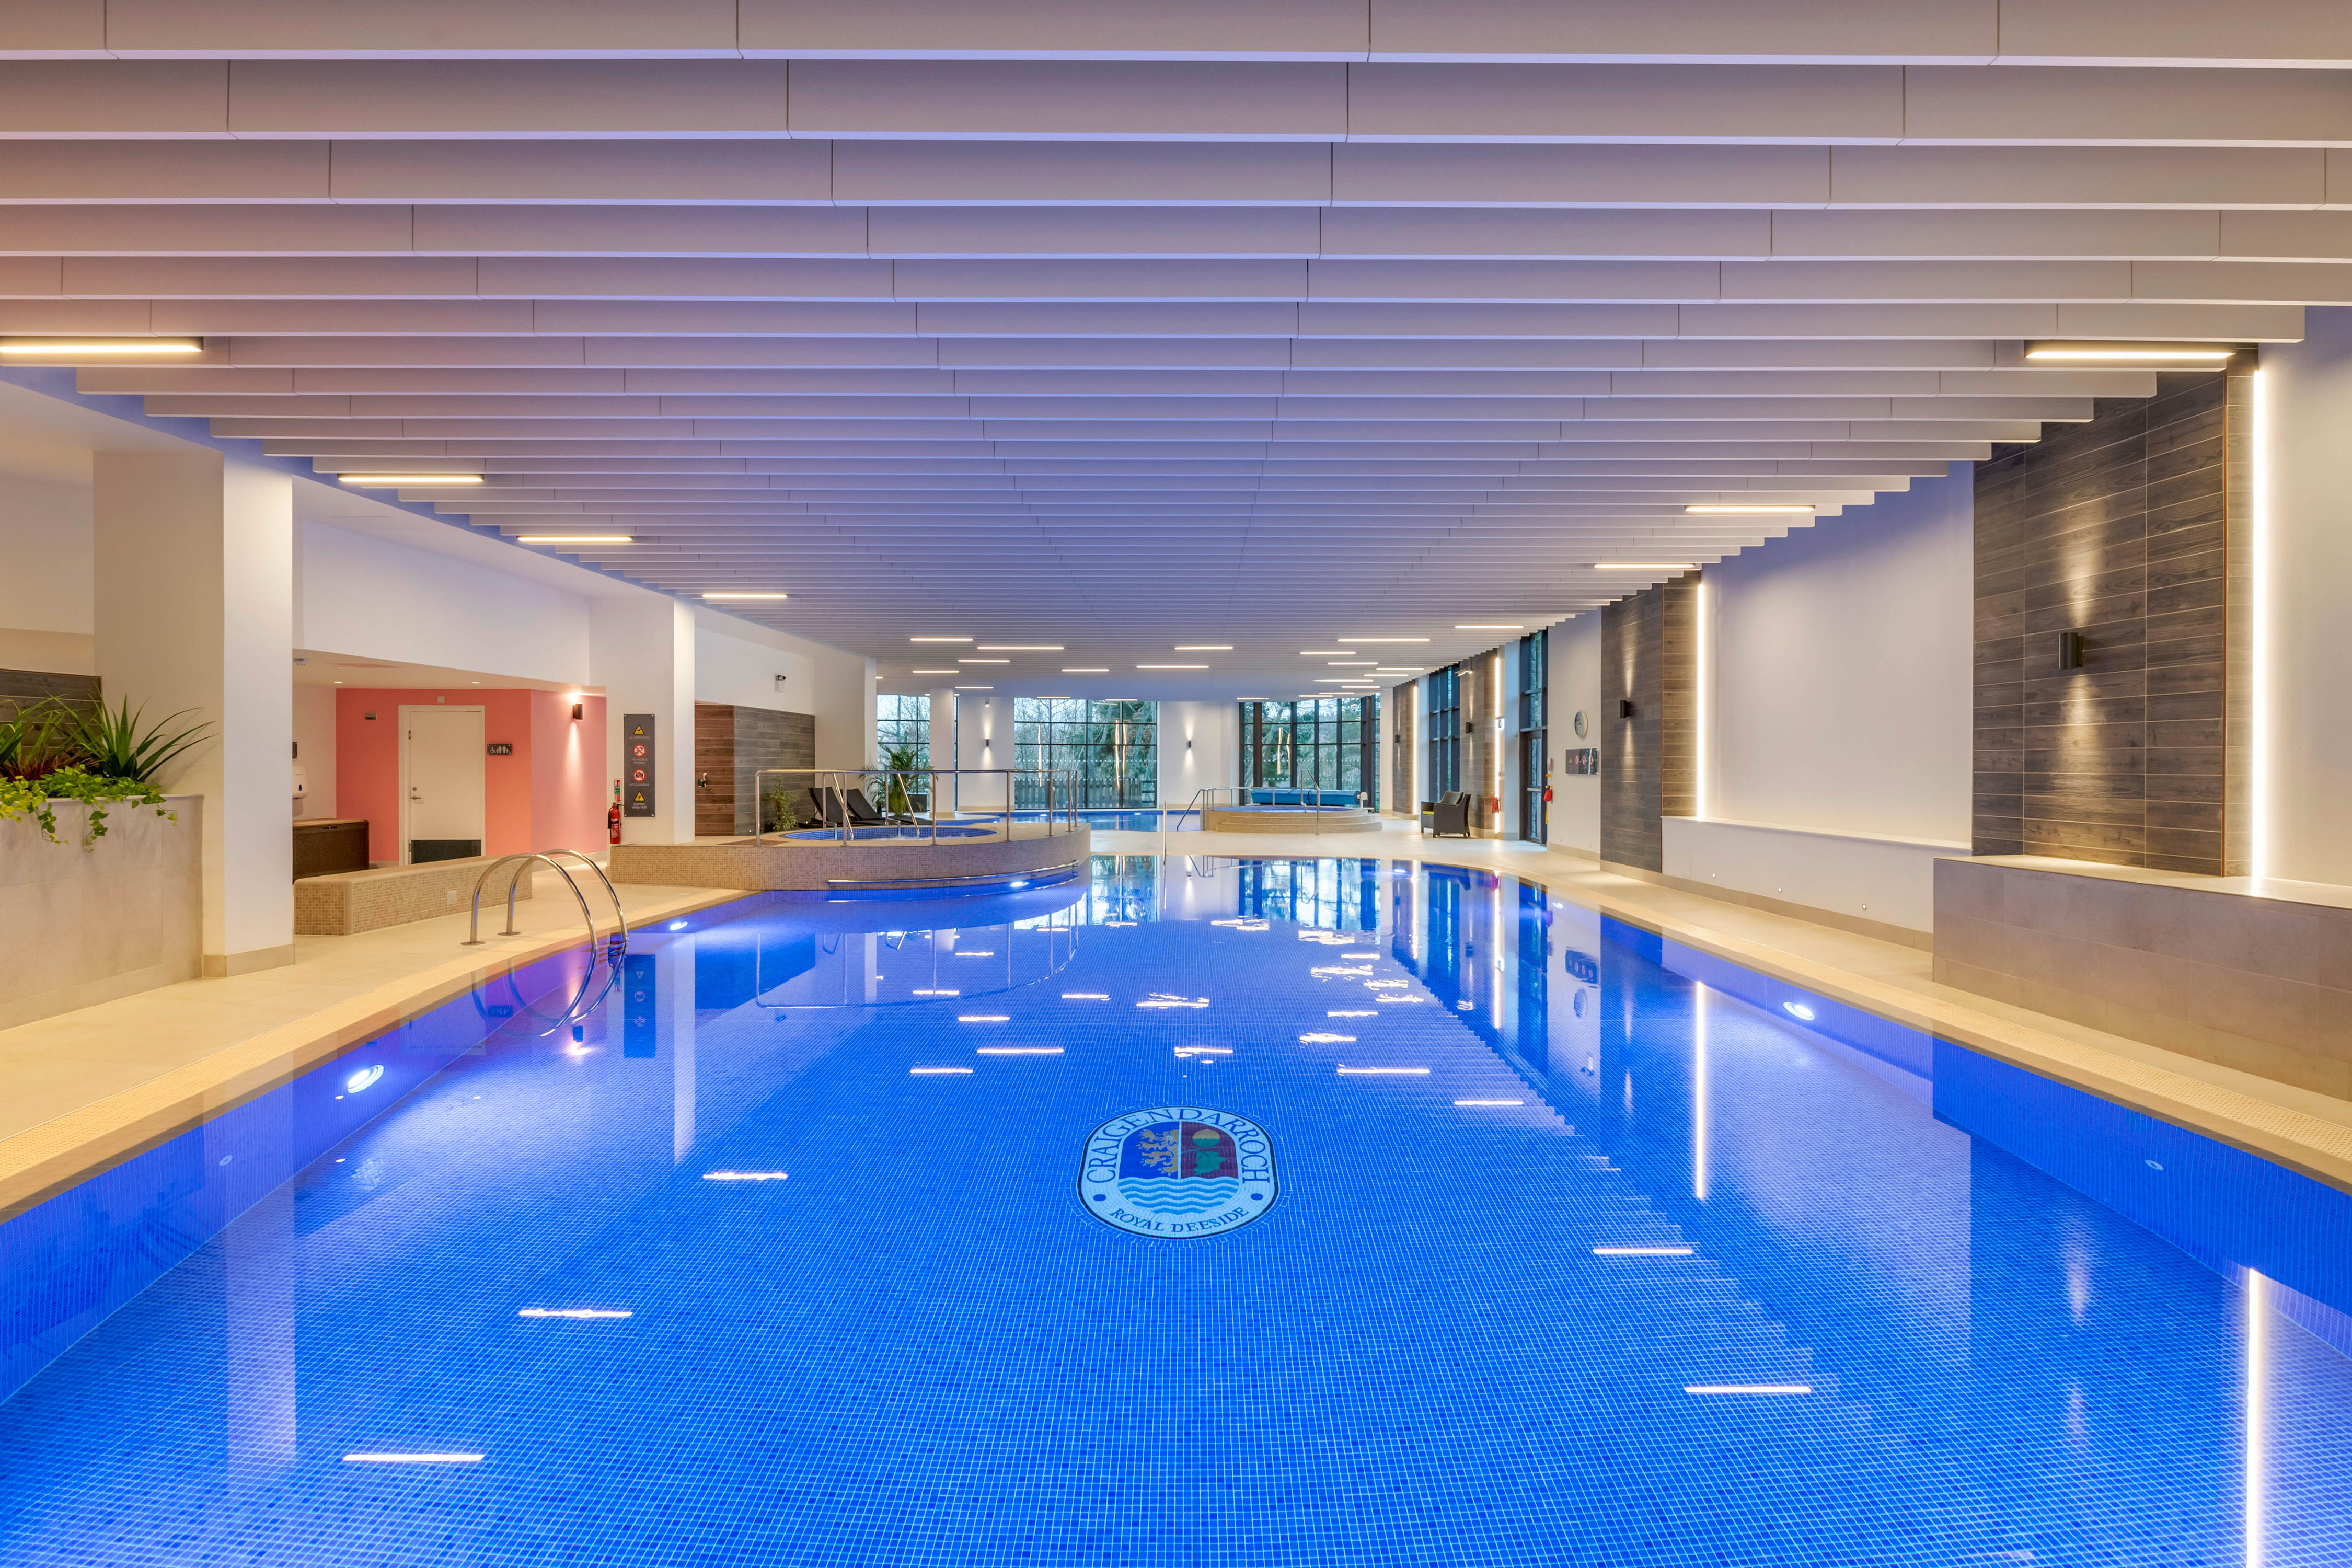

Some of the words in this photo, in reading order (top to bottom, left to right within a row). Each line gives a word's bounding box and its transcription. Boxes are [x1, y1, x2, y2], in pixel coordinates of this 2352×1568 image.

[1087, 1108, 1270, 1183] CRAIGENDARROCH
[1109, 1207, 1165, 1232] ROYAL
[1171, 1206, 1250, 1233] DEESIDE
